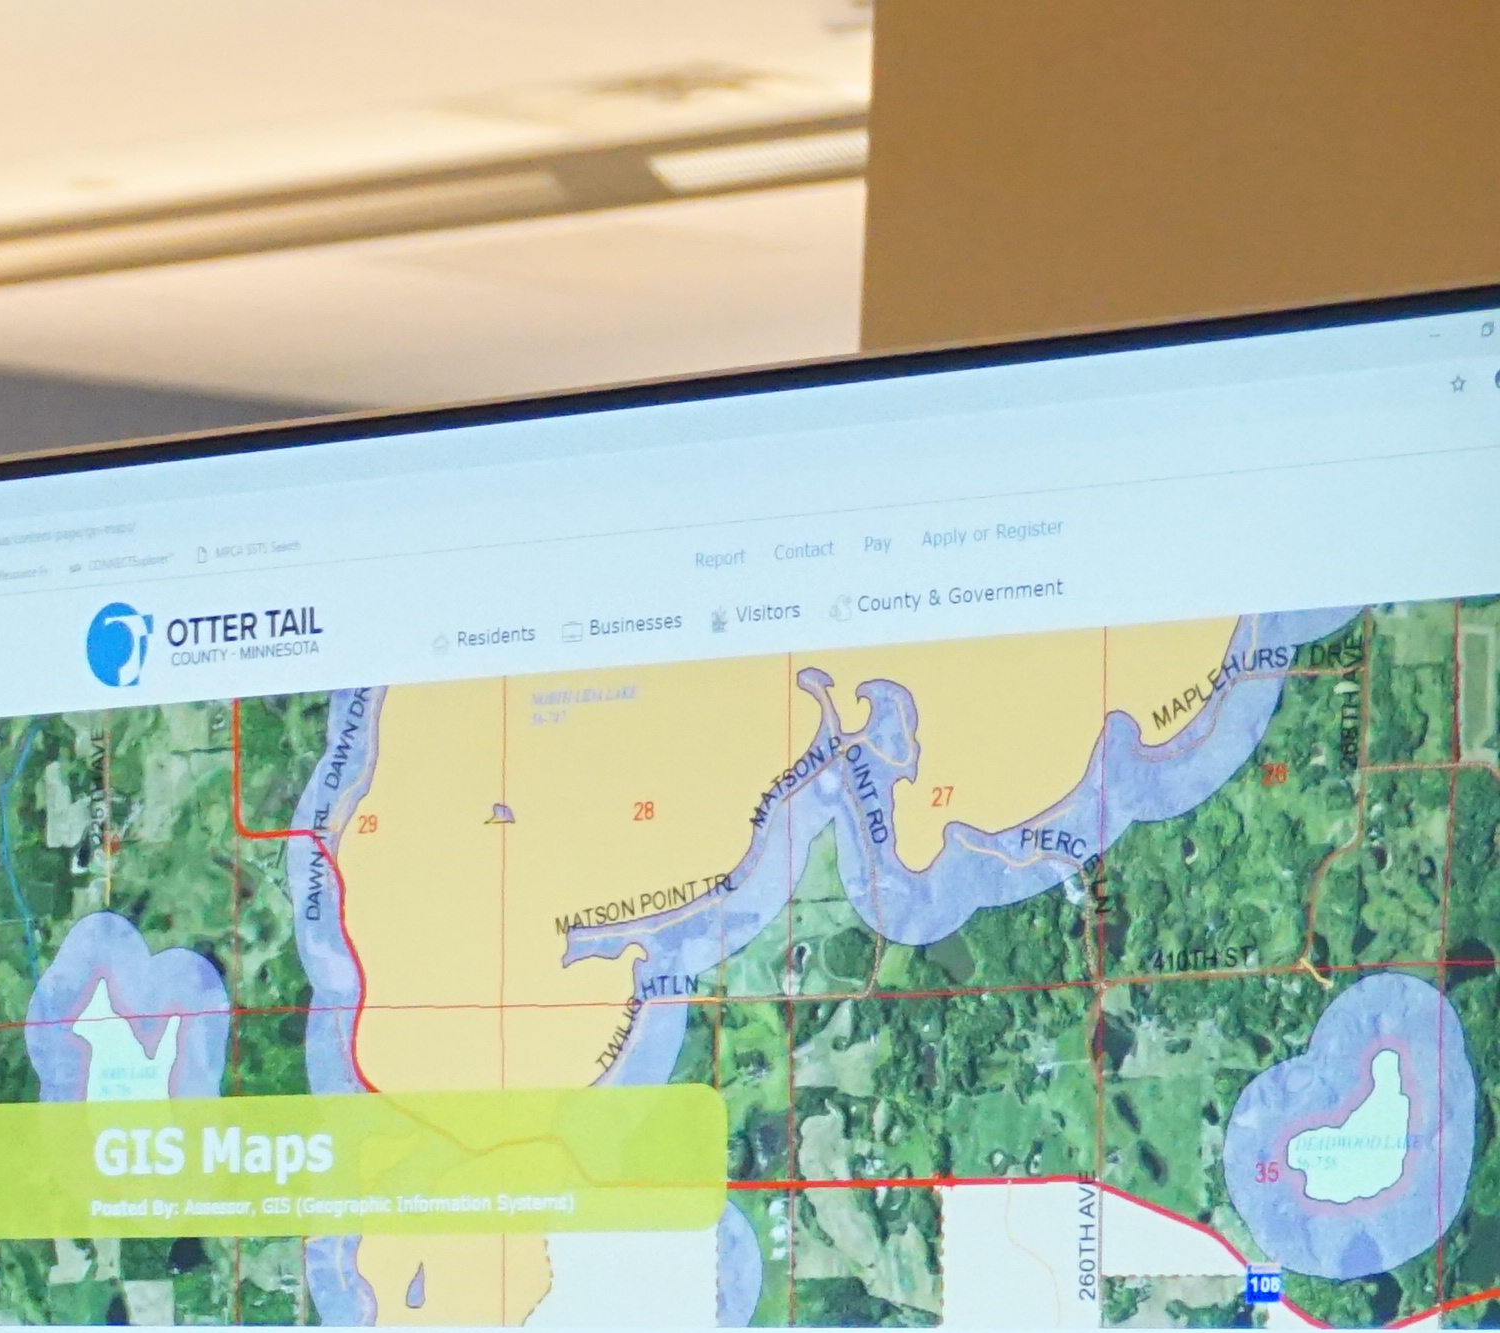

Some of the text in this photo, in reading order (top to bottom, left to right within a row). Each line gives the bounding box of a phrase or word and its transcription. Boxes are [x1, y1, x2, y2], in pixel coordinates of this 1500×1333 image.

[864, 534, 891, 556] Pay
[922, 517, 1064, 549] Apply or Register
[695, 547, 745, 570] Report
[774, 540, 835, 562] Contact
[858, 579, 1064, 617] County & Government
[589, 612, 683, 638] Businesses
[736, 601, 801, 624] Visitors
[166, 606, 323, 648] OTTER TAIL
[457, 624, 536, 648] Residents
[171, 641, 320, 667] COUNTY MINNESOTA
[1152, 644, 1304, 731] MAPLEHURST
[90, 728, 105, 771] AVE
[325, 718, 359, 790] DAWN
[750, 736, 888, 845] MATSON POINT RD
[932, 787, 954, 807] 27
[358, 814, 378, 835] 29
[633, 802, 655, 821] 28
[306, 802, 331, 921] DAWN TRL
[555, 872, 739, 937] MATSON POINT TRL
[1152, 946, 1254, 973] 410TH ST
[94, 1127, 336, 1184] GIS Maps
[1254, 1161, 1280, 1185] 35
[91, 1199, 148, 1217] Posted
[152, 1199, 180, 1220] By:
[261, 1197, 291, 1214] GIS
[296, 1196, 391, 1218] (Geographic
[396, 1195, 492, 1213] Information
[497, 1194, 575, 1215] Systems)
[1078, 1170, 1098, 1302] 260TH AVE
[1250, 1276, 1281, 1293] 108
